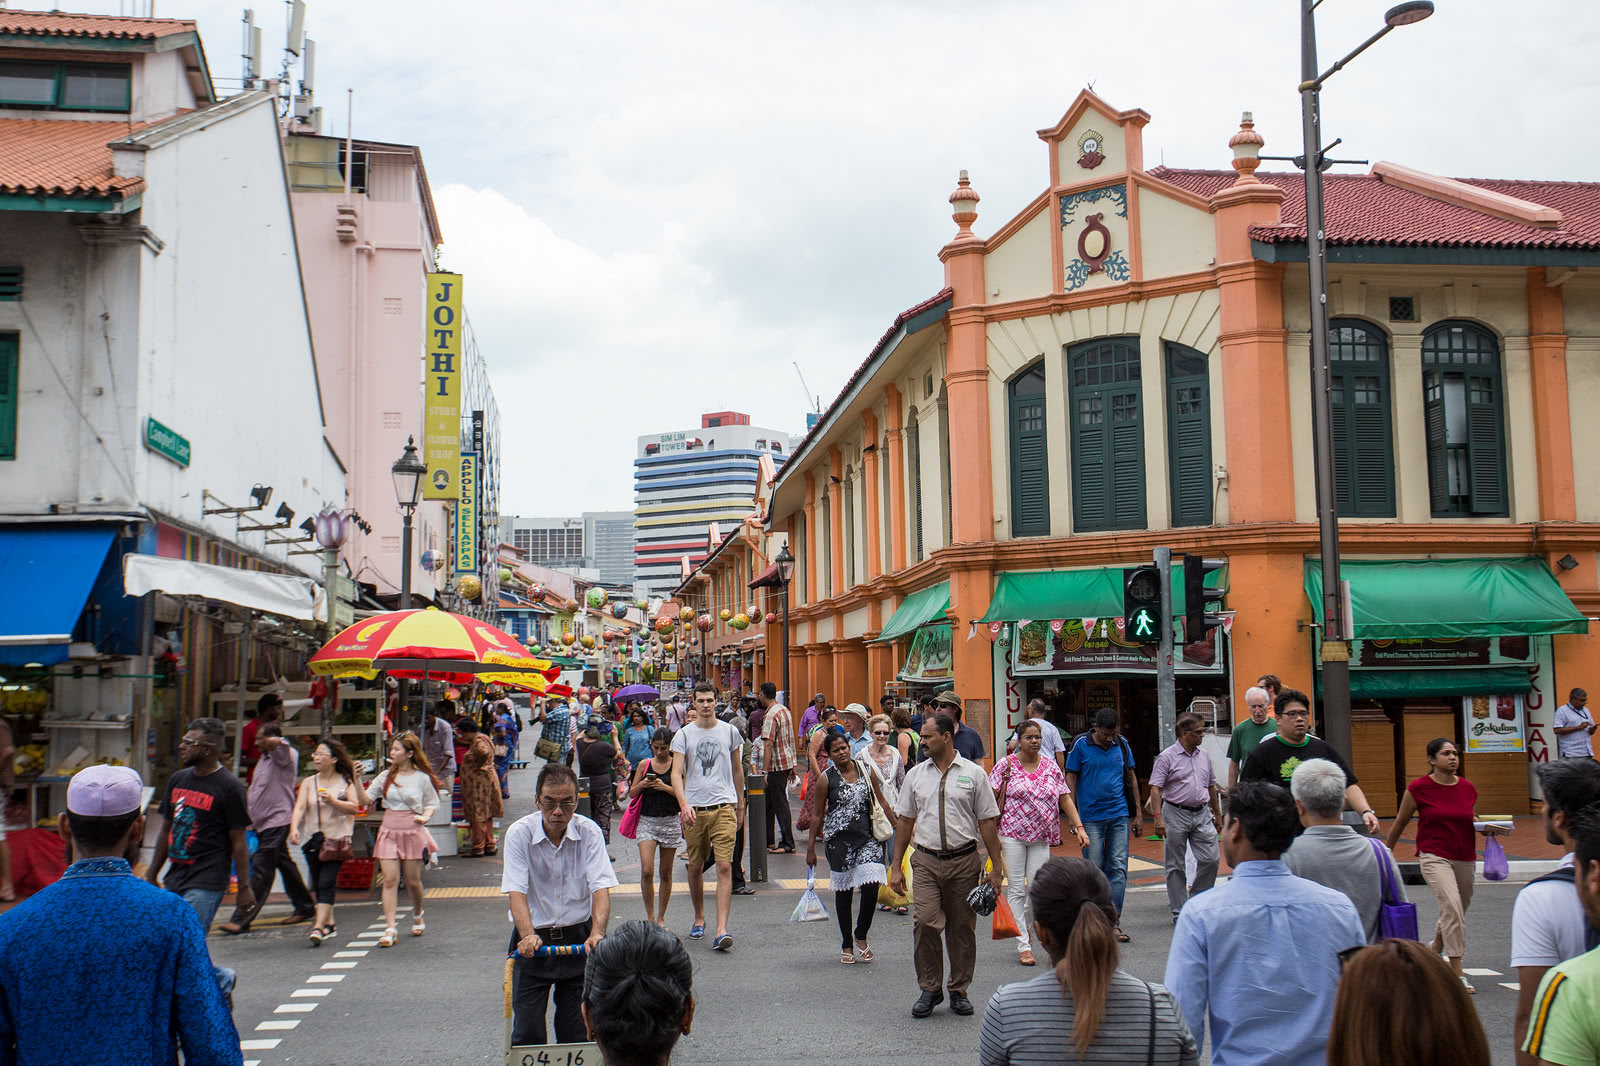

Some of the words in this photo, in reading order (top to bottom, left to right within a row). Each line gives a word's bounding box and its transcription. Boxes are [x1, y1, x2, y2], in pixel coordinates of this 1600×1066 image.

[431, 282, 455, 396] JOTHI
[429, 406, 456, 416] STORE
[150, 421, 176, 451] Campbell
[176, 438, 189, 460] Lane
[427, 435, 457, 446] FLOWER
[660, 435, 672, 443] SIM
[674, 432, 686, 441] LIM
[660, 441, 686, 451] TOWER
[430, 449, 454, 459] SHOP
[461, 458, 472, 505] APPOLLO
[461, 508, 472, 568] SELLAPPAS
[1166, 654, 1172, 666] 2
[1471, 722, 1518, 736] Gokulam
